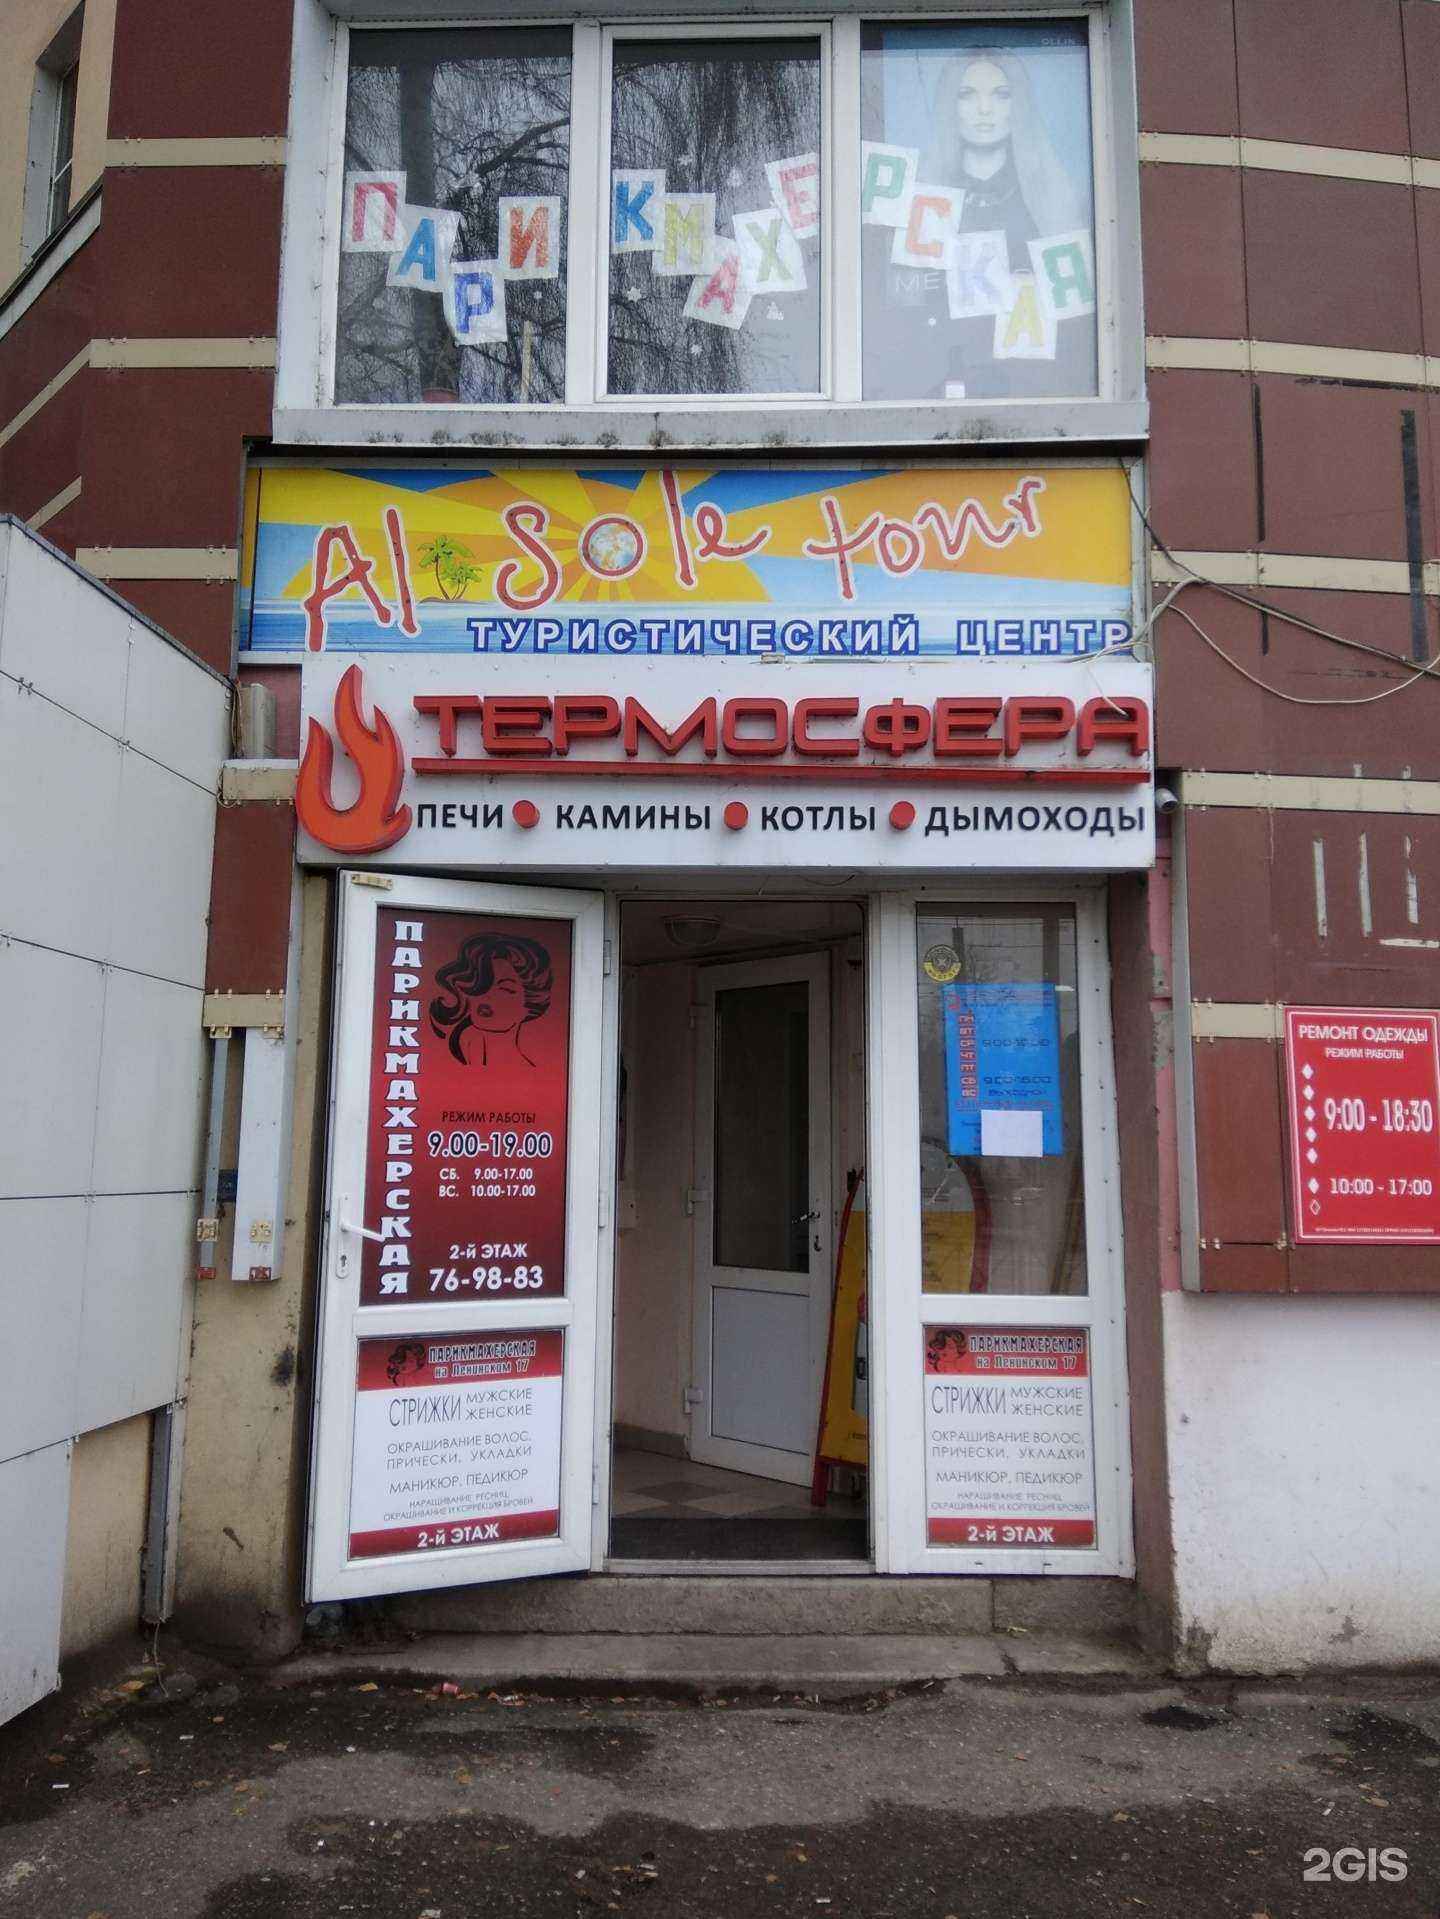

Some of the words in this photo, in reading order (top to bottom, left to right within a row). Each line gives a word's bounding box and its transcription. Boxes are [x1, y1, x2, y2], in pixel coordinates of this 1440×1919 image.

[353, 150, 1095, 350] ПАРИКМАХЕРСКАЯ
[467, 612, 920, 656] ТУРИСТИЧЕСКИЙ
[956, 618, 1134, 656] ЦЕНТР
[412, 694, 1150, 758] ТЕРМОСФЕРА
[416, 802, 504, 830] ПЕЧИ
[555, 804, 712, 832] КАМИНЫ
[760, 805, 876, 832] КОТЛЫ
[924, 805, 1145, 837] ДЫМОХОДЫ
[1299, 1025, 1358, 1041] РЕМОНТ
[1362, 1027, 1428, 1043] ОДЕЖДЫ
[1325, 1047, 1363, 1058] РЕЖИМ
[1365, 1048, 1404, 1059] РАБОТЫ
[378, 919, 426, 1296] ПАРИКМАХЕРСКАЯ
[1324, 1098, 1366, 1131] 9:00
[1382, 1099, 1433, 1132] 18:30
[441, 1111, 486, 1123] РЕЖИМ
[489, 1112, 537, 1124] РАБОТЫ
[427, 1130, 553, 1158] 9.00-19.00
[439, 1168, 460, 1180] СБ.
[474, 1168, 533, 1180] 9.00-17.00
[438, 1185, 459, 1197] ВС.
[470, 1185, 536, 1198] 10.00-17.00
[1330, 1178, 1374, 1194] 10:00
[1389, 1178, 1432, 1195] 17:00
[481, 1243, 528, 1259] ЭТАЖ
[428, 1266, 544, 1292] 76-98-83
[428, 1340, 536, 1363] ПАРИКМАХЕРСКАЯ
[970, 1335, 1083, 1353] ПАРИКМАХЕРСКАЯ
[516, 1358, 529, 1372] 17
[389, 1396, 461, 1427] СТРИЖКИ
[466, 1388, 533, 1404] МУЖСКИЕ
[931, 1386, 1006, 1414] СТРИЖКИ
[1010, 1387, 1083, 1400] МУЖСКИЕ
[466, 1404, 533, 1420] ЖЕНСКИЕ
[1011, 1404, 1084, 1417] ЖЕНСКИЕ
[387, 1435, 482, 1455] ОКРАШИВАНИЕ
[931, 1431, 1030, 1443] ОКРАШИВАНИЕ
[471, 1446, 532, 1463] УКЛАДКИ
[1019, 1448, 1086, 1460] УКЛАДКИ
[466, 1468, 529, 1486] ПЕДИКЮР
[1015, 1472, 1083, 1485] ПЕДИКЮР
[450, 1523, 500, 1544] ЭТАЖ
[1002, 1528, 1055, 1542] ЭТАЖ
